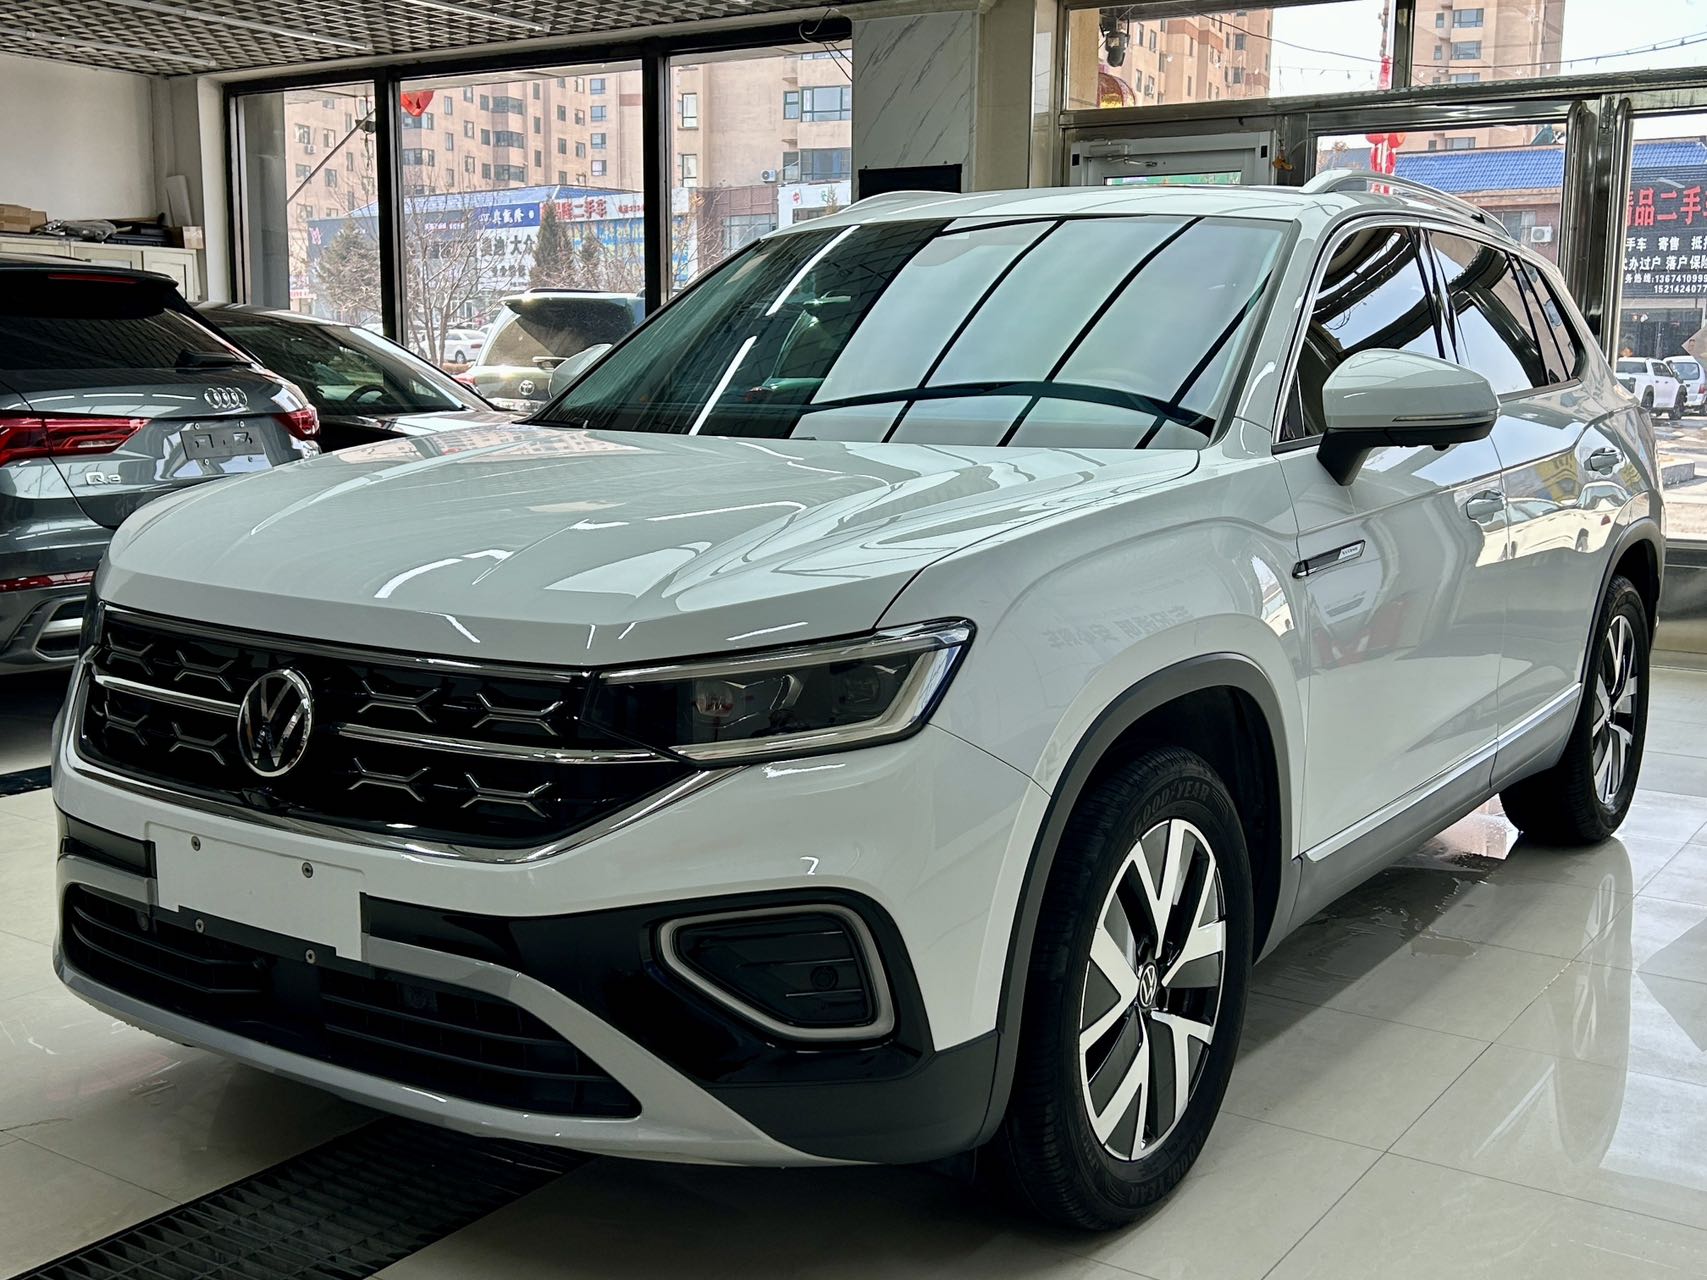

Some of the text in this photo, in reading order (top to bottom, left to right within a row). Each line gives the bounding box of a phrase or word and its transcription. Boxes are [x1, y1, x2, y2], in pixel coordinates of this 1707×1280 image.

[1628, 185, 1707, 226] 品二手
[510, 234, 535, 255] 大众
[1658, 236, 1680, 251] 寄售
[86, 471, 121, 485] Q3
